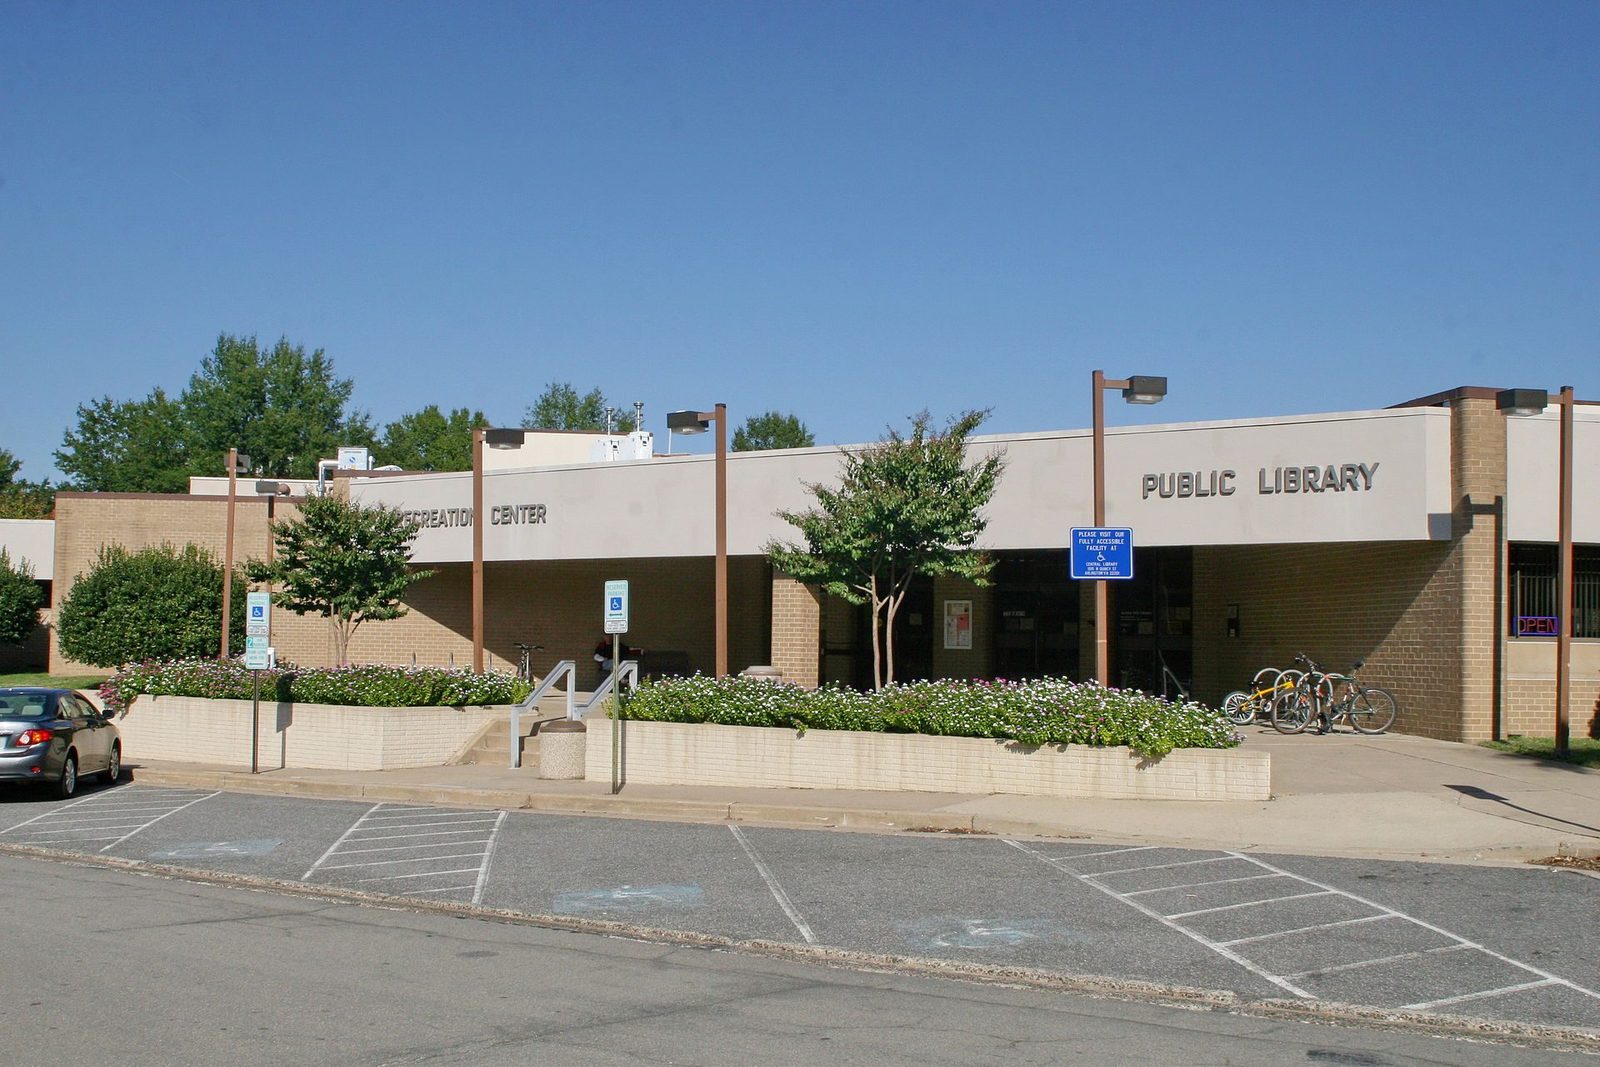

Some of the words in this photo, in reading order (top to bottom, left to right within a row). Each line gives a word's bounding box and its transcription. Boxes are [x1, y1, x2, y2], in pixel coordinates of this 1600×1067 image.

[1142, 469, 1236, 500] PUBLIC
[1259, 462, 1380, 494] LIBRARY
[490, 503, 547, 526] CENTER
[1518, 618, 1556, 633] OPEN
